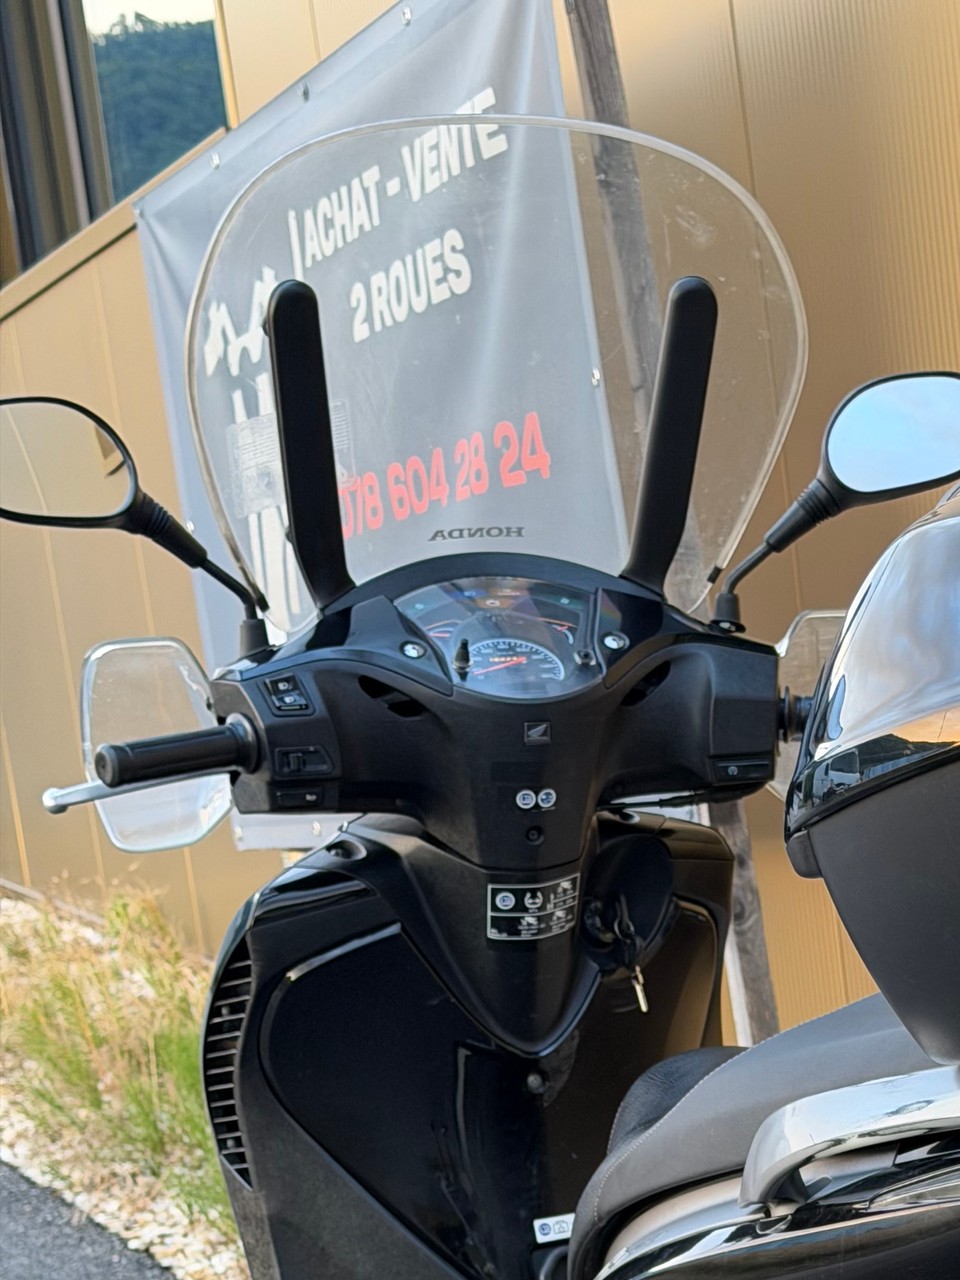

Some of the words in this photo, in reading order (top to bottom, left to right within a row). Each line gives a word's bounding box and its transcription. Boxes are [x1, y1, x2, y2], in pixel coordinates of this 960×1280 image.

[350, 262, 370, 343] 2
[370, 228, 472, 332] ROUES
[387, 447, 449, 521] 604
[454, 432, 489, 502] 28
[493, 411, 550, 488] 24
